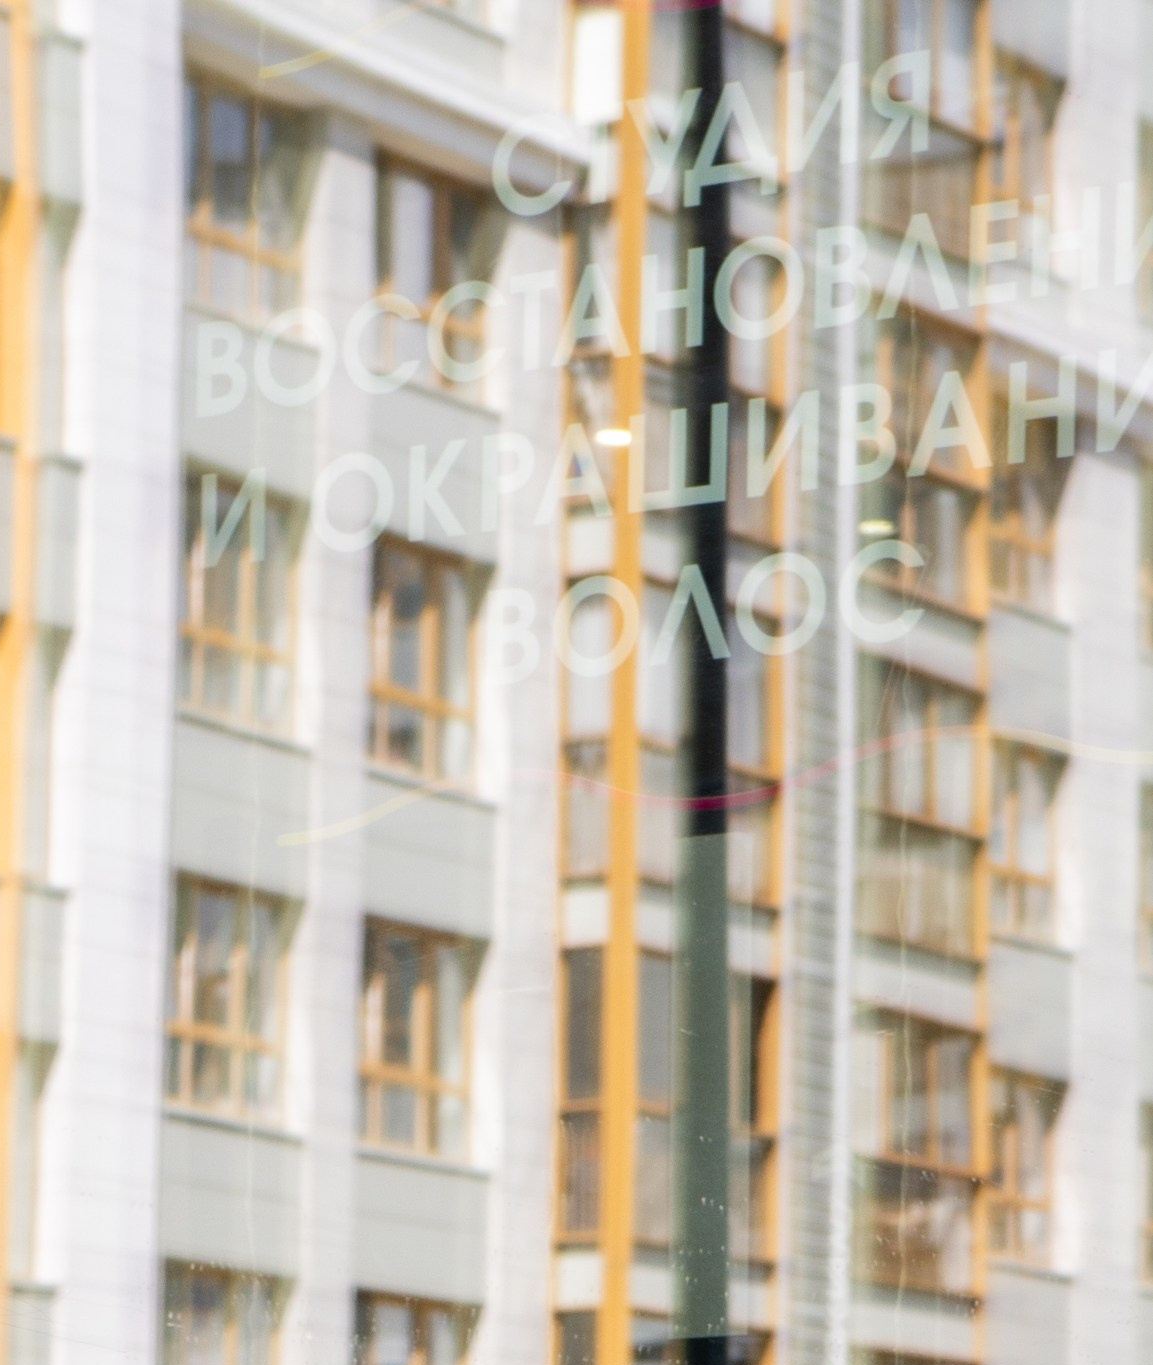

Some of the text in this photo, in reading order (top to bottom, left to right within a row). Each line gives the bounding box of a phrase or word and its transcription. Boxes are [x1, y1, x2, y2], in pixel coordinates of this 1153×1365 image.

[492, 49, 933, 217] СТУДИЯ
[200, 345, 1153, 569] И ОКРАШИВАНИ
[485, 538, 927, 687] ВОЛОС
